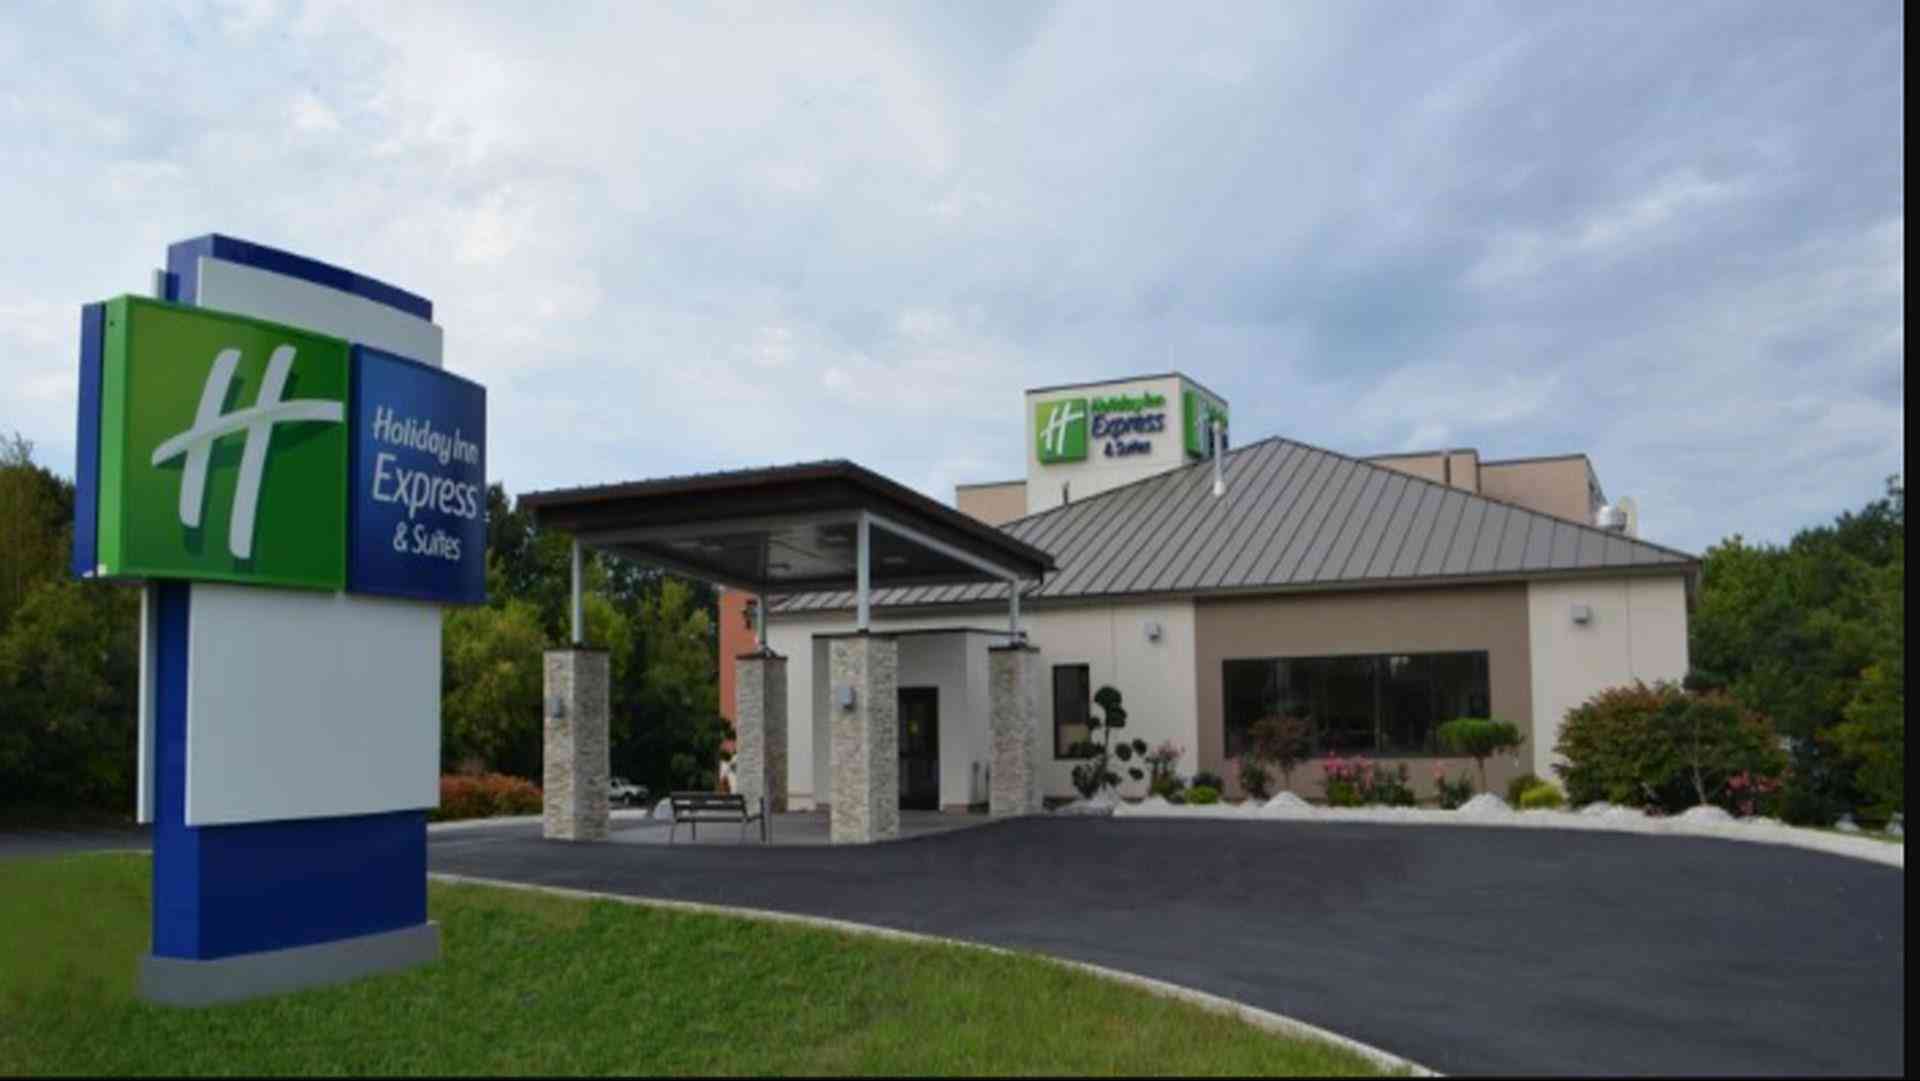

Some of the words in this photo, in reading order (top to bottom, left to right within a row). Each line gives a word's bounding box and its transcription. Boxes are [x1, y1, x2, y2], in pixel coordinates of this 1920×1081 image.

[372, 405, 451, 464] Holiday
[453, 428, 479, 464] Inn
[1092, 413, 1165, 439] Express
[1116, 440, 1152, 457] Suites
[373, 452, 478, 519] Express
[392, 521, 408, 551] &
[412, 523, 461, 560] Suites
